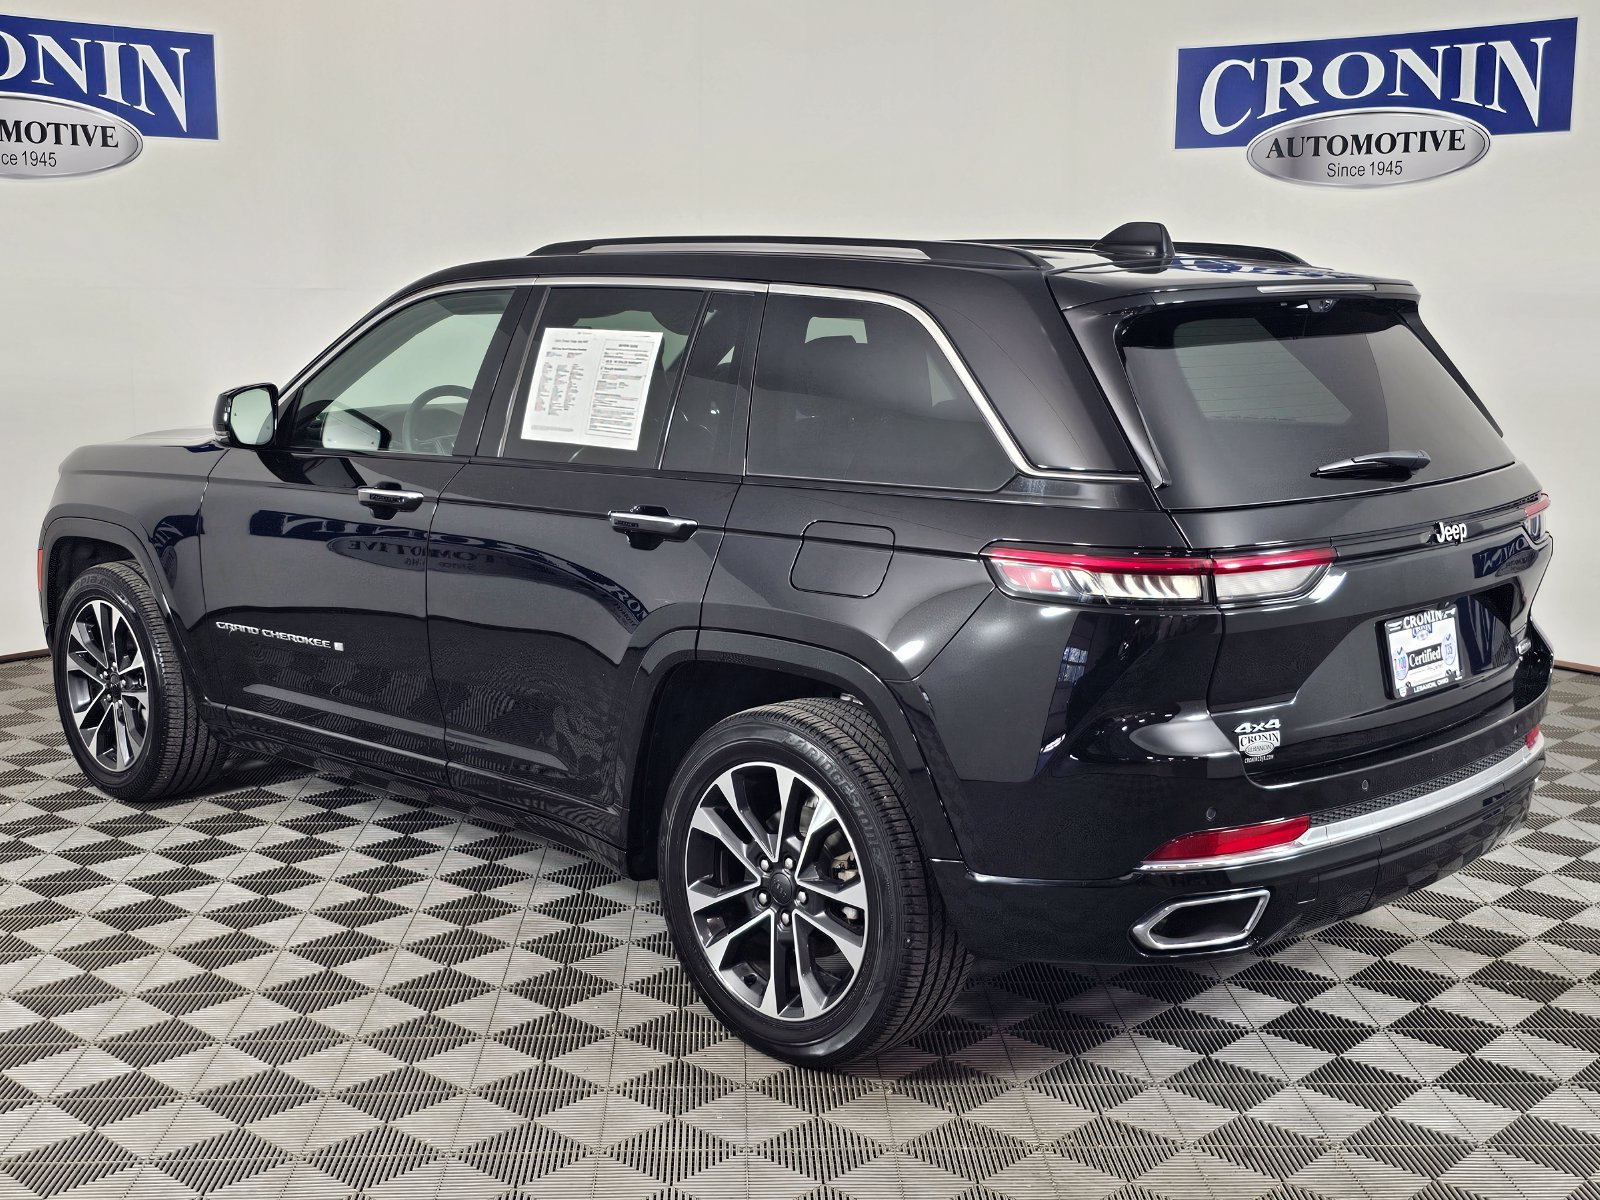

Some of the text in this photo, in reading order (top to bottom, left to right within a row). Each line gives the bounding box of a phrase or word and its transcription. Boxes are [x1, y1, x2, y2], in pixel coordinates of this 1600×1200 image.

[1199, 37, 1552, 135] CRONIN
[0, 119, 119, 148] MOTIVE
[1266, 129, 1466, 159] AUTOMOTIVE
[1, 150, 57, 167] ce 1945
[1326, 161, 1403, 178] Since 1945
[1436, 521, 1467, 543] Jeep
[1403, 610, 1443, 629] CRONIN
[215, 621, 332, 649] GRAND CHEROKEE
[1408, 645, 1442, 668] Certified
[1234, 718, 1281, 733] 4x4
[1240, 733, 1279, 747] CRONIN
